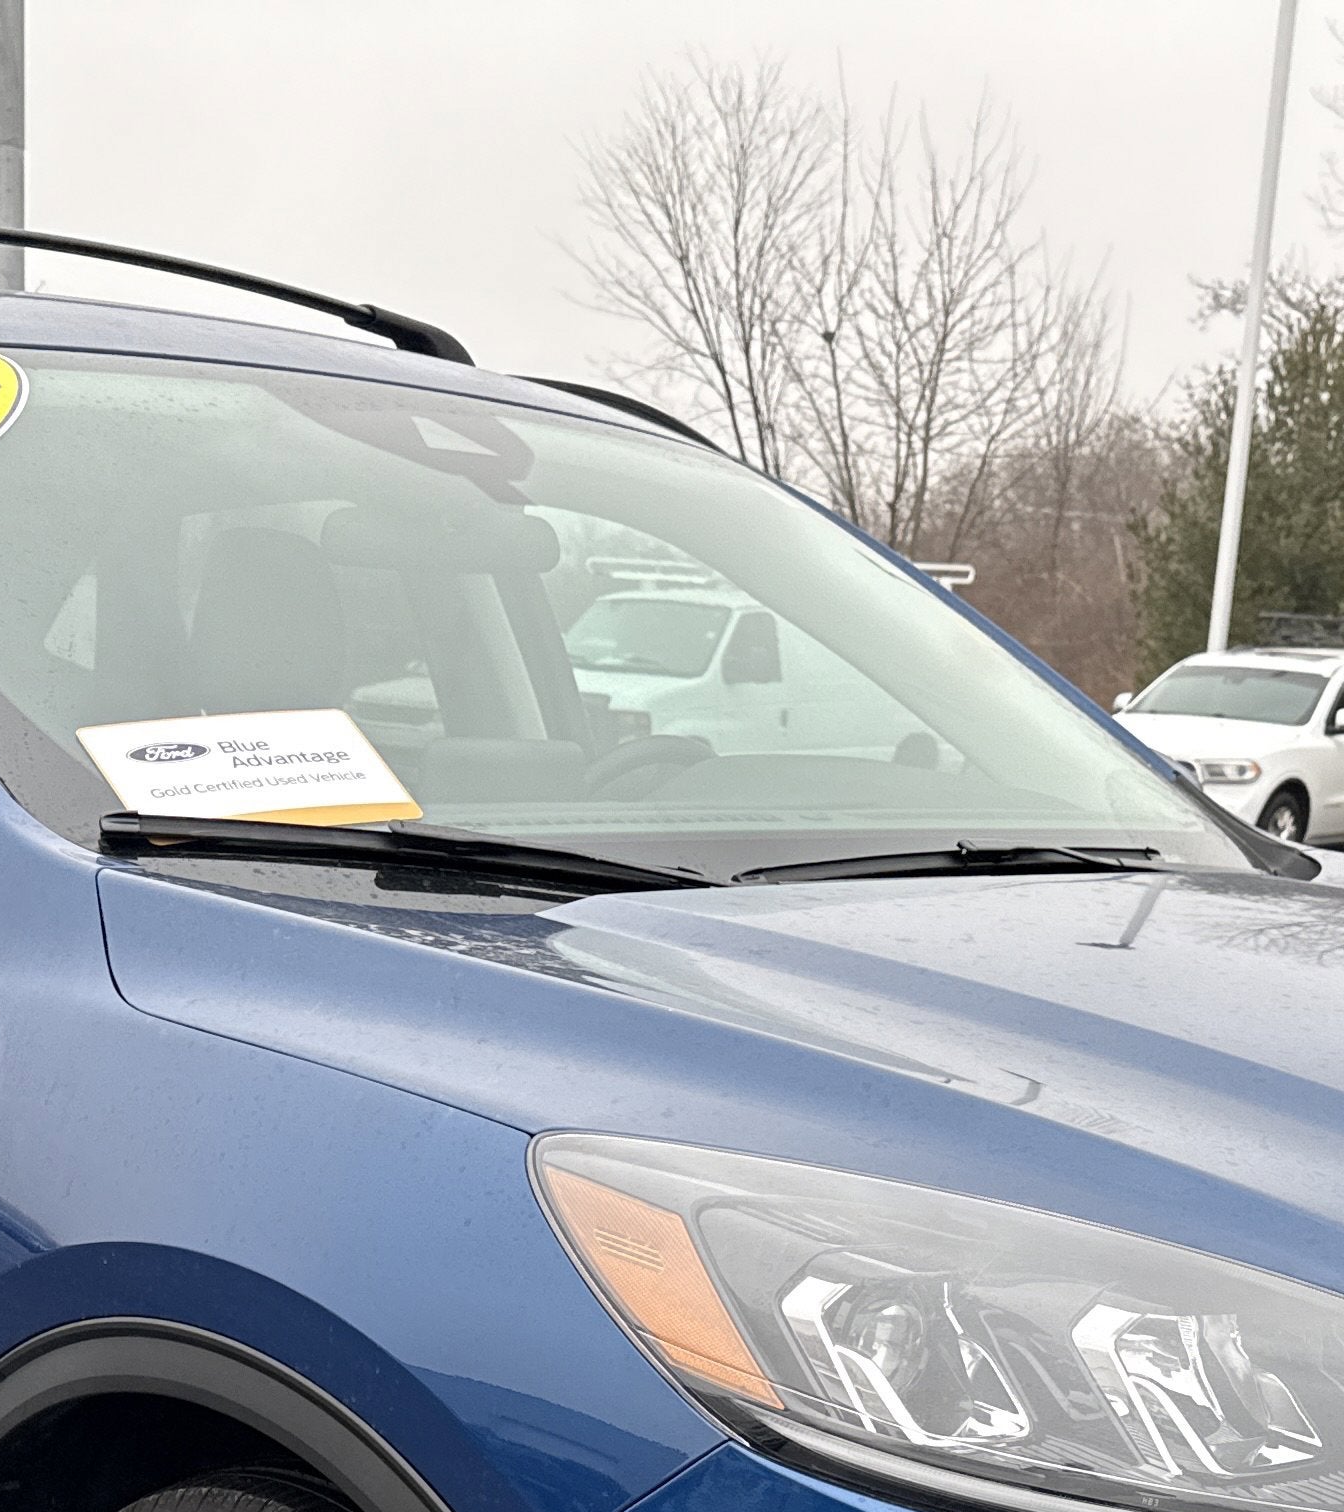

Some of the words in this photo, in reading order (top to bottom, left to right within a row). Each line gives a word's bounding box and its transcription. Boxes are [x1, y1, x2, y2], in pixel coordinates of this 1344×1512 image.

[144, 744, 196, 762] Ford
[217, 739, 270, 754] Blue
[232, 750, 352, 768] Advantage
[150, 785, 191, 799] Gold
[193, 778, 264, 794] Certified
[265, 774, 307, 787] Used
[309, 770, 367, 783] Vehicle
